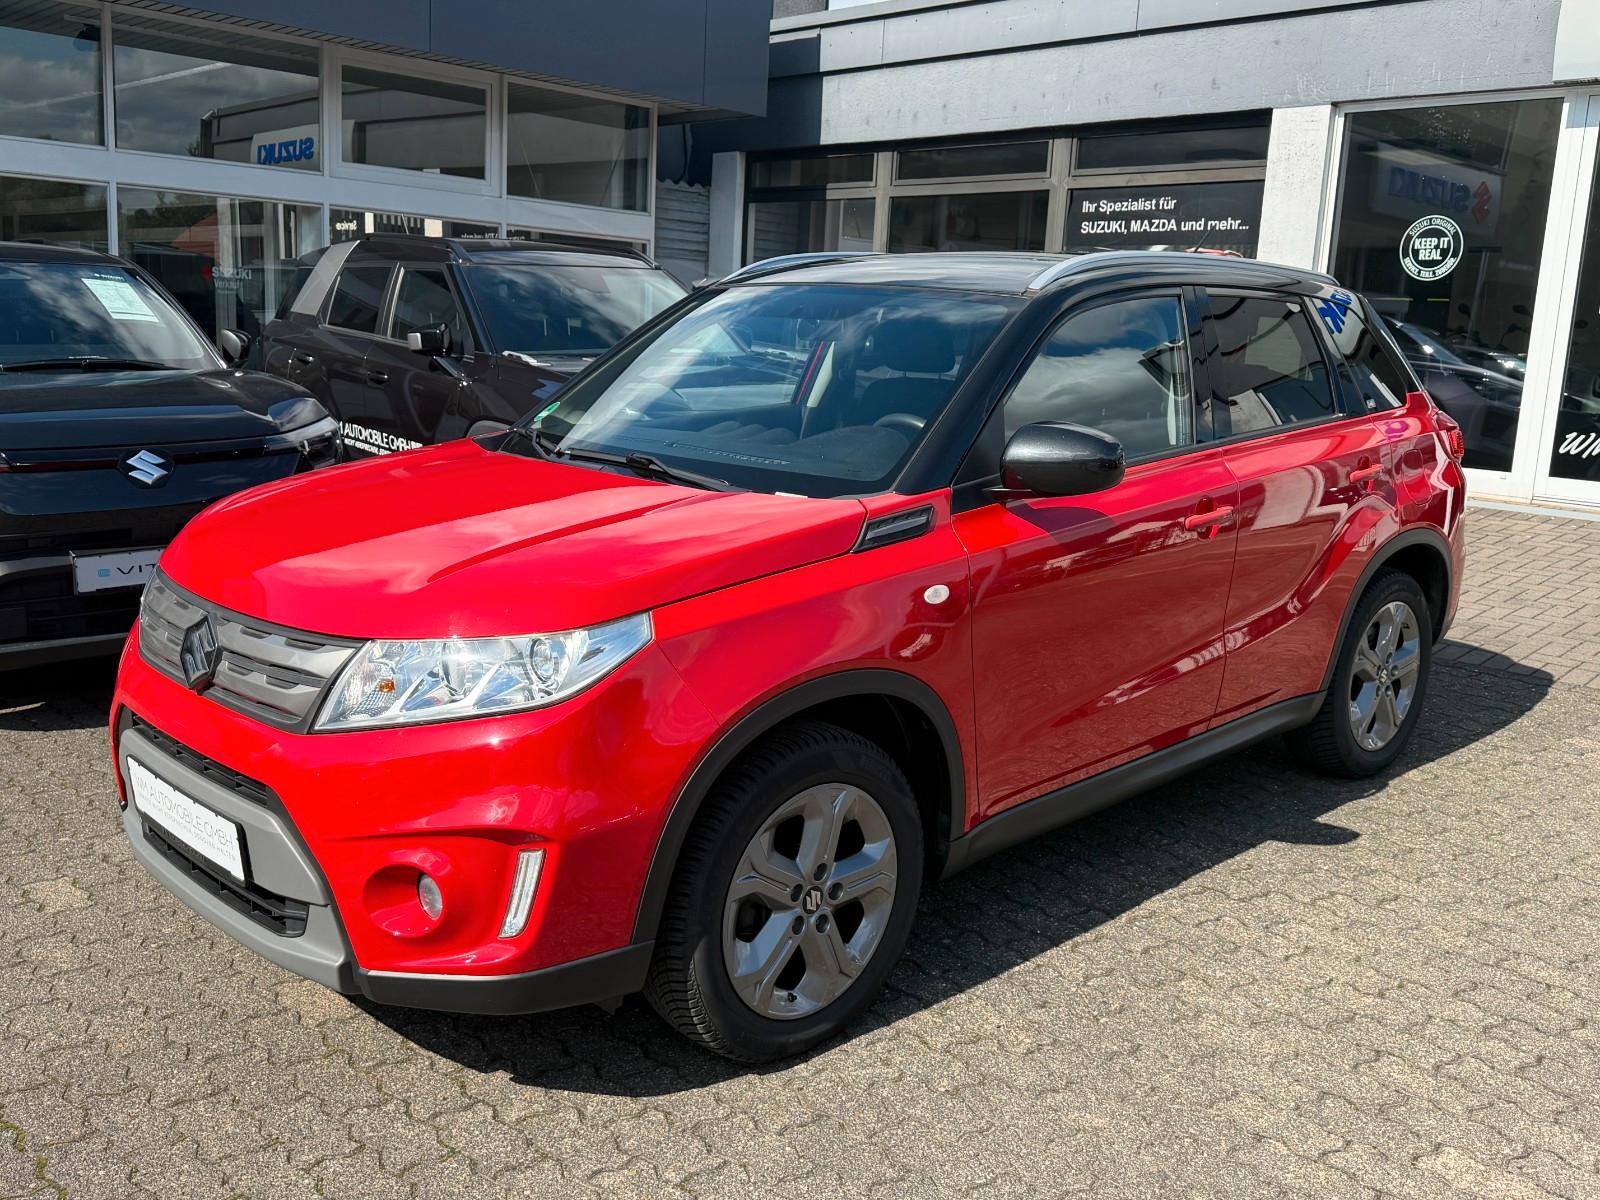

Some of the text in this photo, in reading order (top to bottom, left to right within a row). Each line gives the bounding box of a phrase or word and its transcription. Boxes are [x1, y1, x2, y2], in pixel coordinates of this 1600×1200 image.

[1082, 196, 1177, 215] Ihr Spezialist für
[1080, 217, 1249, 235] SUZUKI, MAZDA und mehr...
[1409, 218, 1457, 236] SUZUKI ORIGINAL
[1414, 237, 1450, 250] KEEP IT
[1418, 248, 1442, 260] REAL
[344, 422, 389, 449] AUTOMOBILE
[149, 785, 203, 833] AUTOMOBILE
